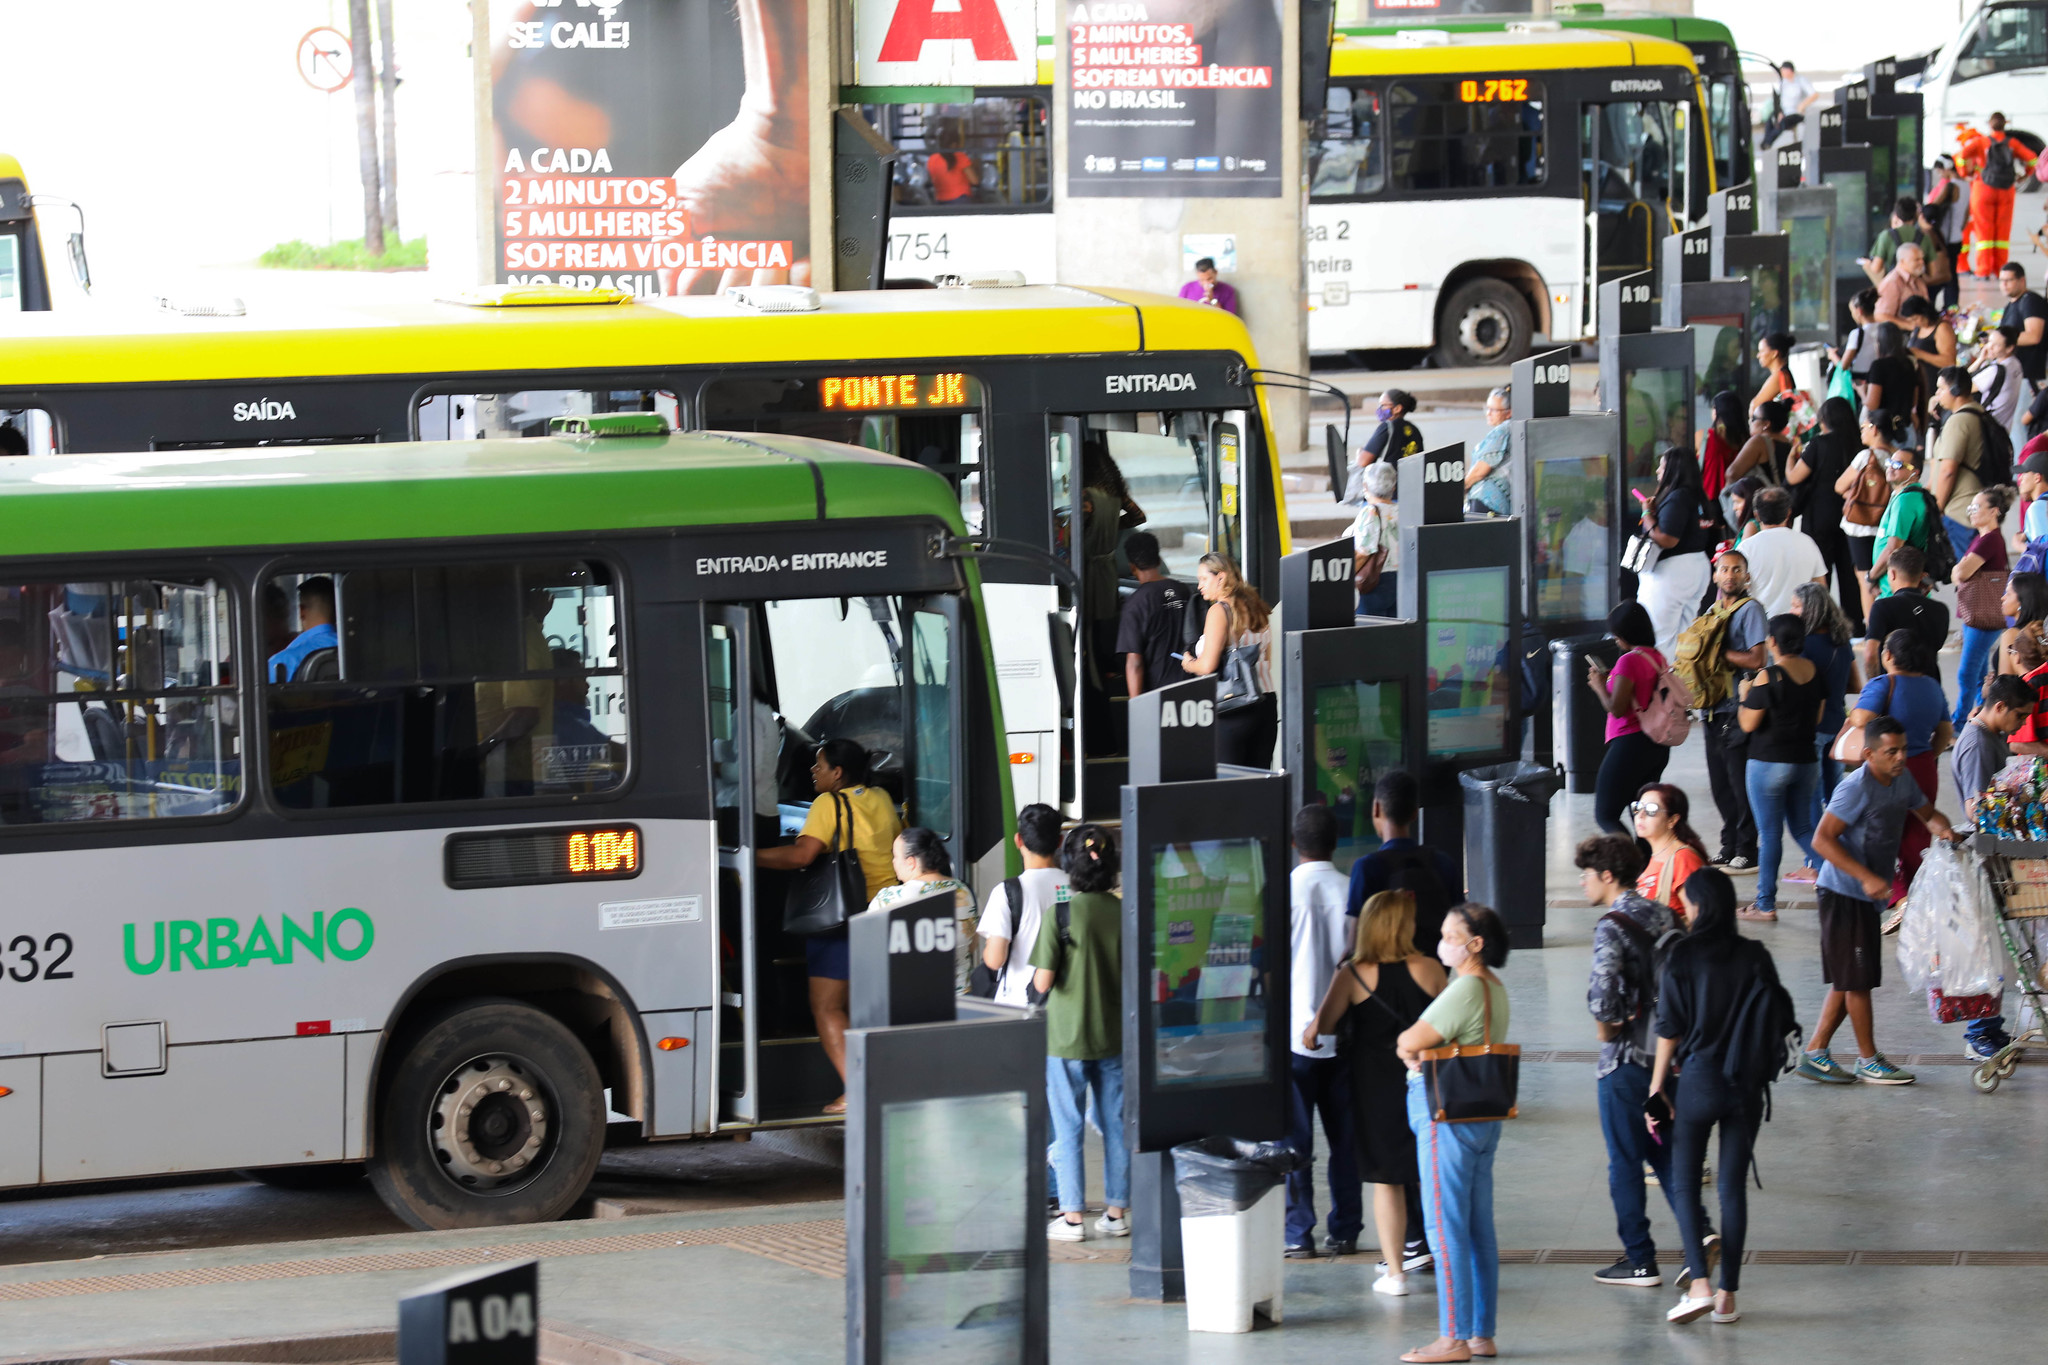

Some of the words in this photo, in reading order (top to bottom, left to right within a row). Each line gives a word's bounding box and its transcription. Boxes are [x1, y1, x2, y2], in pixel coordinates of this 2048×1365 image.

[1072, 4, 1089, 21] A
[1097, 4, 1148, 21] CADA
[508, 22, 544, 48] SE
[551, 22, 629, 48] CALE!
[877, 0, 1018, 62] A
[1073, 26, 1086, 43] 2
[1089, 25, 1192, 46] MINUTOS,
[1074, 48, 1086, 65] 5
[1090, 47, 1198, 65] MULHERES
[1074, 68, 1157, 86] SOFREM
[1161, 64, 1268, 86] VIOLÊNCIA
[1611, 80, 1662, 92] ENTRADA
[1074, 91, 1106, 108] NO
[1110, 90, 1186, 108] BRASIL.
[1461, 79, 1527, 102] 0.762
[504, 148, 525, 173] A
[530, 148, 613, 173] CADA
[1779, 152, 1788, 165] A
[505, 181, 522, 205] 2
[528, 178, 676, 209] MINUTOS,
[1727, 195, 1738, 210] A
[1739, 195, 1751, 210] 12
[507, 211, 522, 236] 5
[529, 211, 684, 237] MULHERES
[1337, 220, 1349, 240] 2
[507, 242, 626, 269] SOFREM
[632, 236, 788, 268] VIOLÊNCIA
[1684, 240, 1696, 255] A
[1697, 239, 1708, 254] 11
[1621, 287, 1633, 302] A
[1634, 286, 1650, 302] 10
[1105, 373, 1197, 394] ENTRADA
[1534, 366, 1547, 384] A
[1548, 365, 1569, 383] 09
[823, 375, 918, 407] PONTE
[928, 373, 964, 404] JK
[232, 397, 297, 422] SAÍDA
[1425, 462, 1438, 482] A
[1440, 461, 1464, 482] 08
[696, 558, 780, 576] ENTRADA
[792, 550, 887, 571] ENTRANCE
[1310, 558, 1325, 581] A
[1327, 557, 1352, 581] 07
[1161, 702, 1177, 727] A
[1180, 700, 1214, 727] 06
[568, 831, 635, 873] 0.104
[123, 907, 375, 975] URBANO
[889, 920, 909, 953] A
[914, 917, 954, 951] 05
[0, 933, 74, 983] 32
[450, 1299, 477, 1343] A
[480, 1293, 534, 1340] 04
